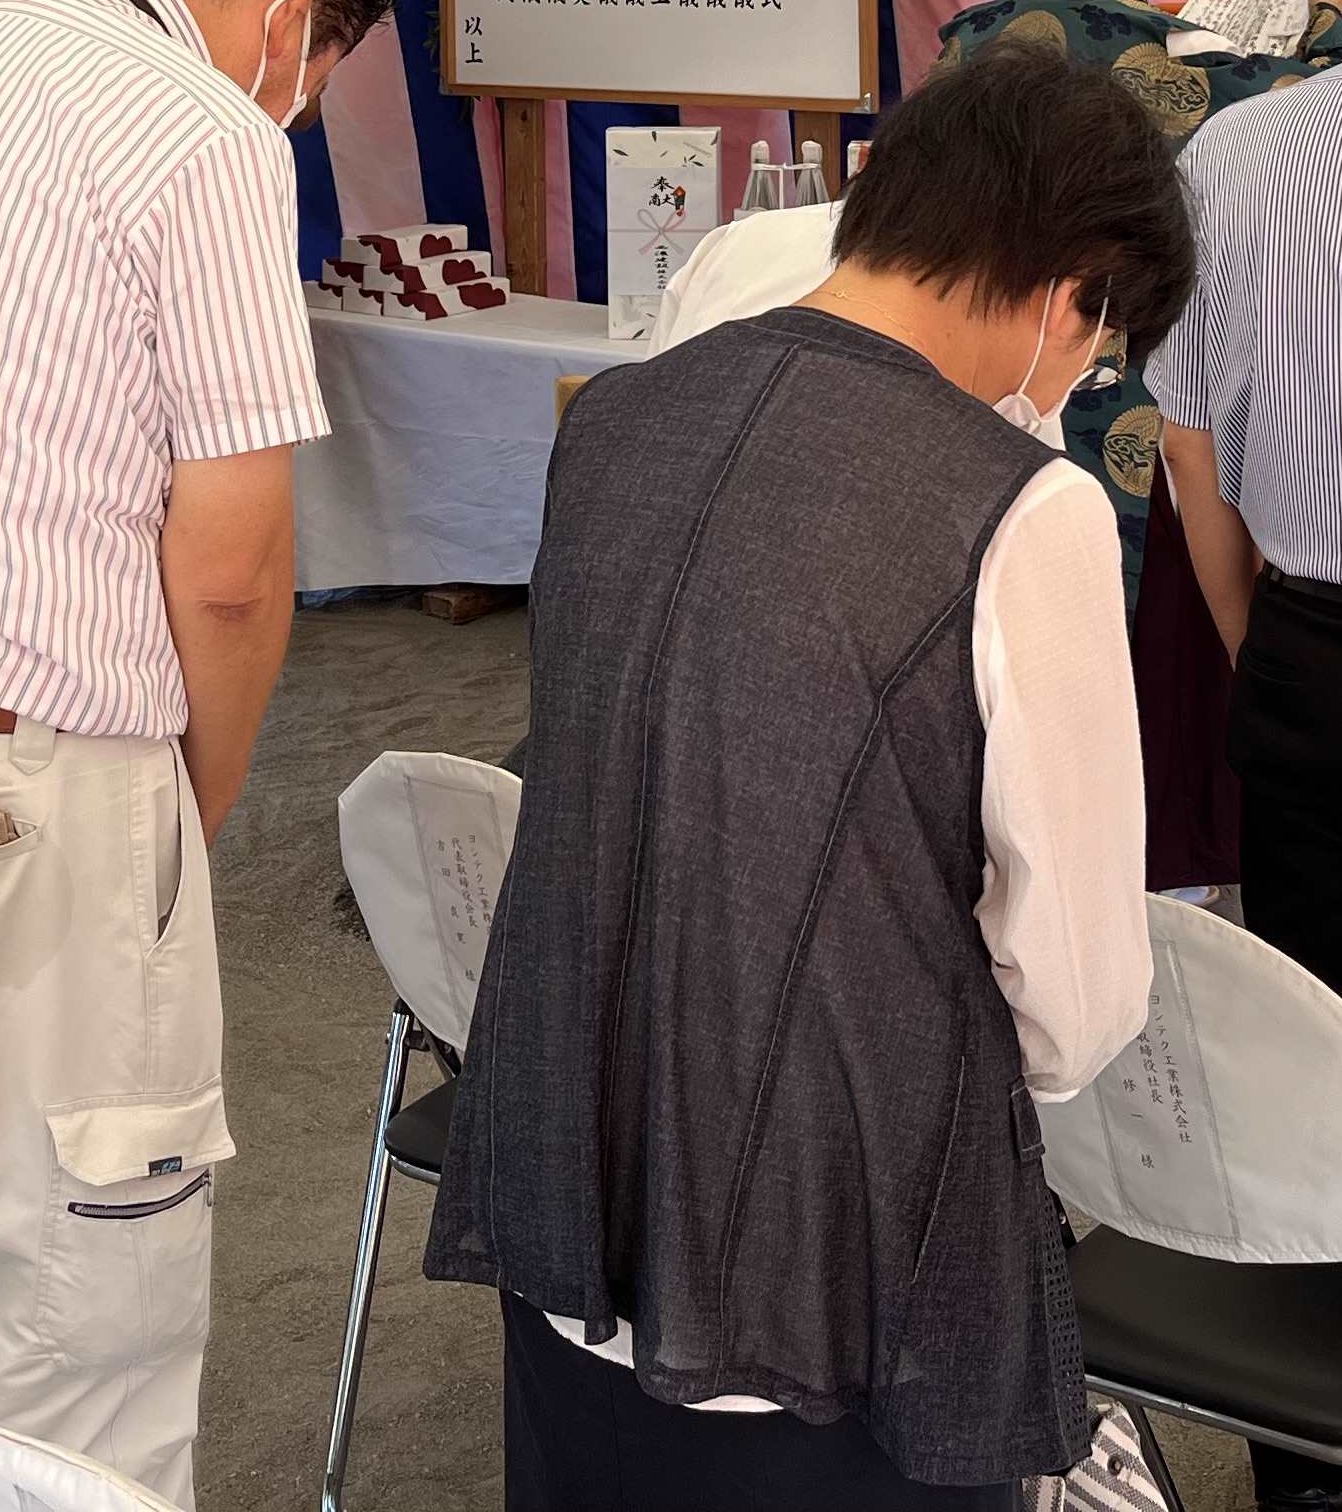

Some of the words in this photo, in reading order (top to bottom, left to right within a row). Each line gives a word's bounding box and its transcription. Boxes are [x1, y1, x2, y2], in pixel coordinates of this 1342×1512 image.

[464, 16, 484, 64] 以上
[1150, 994, 1193, 1144] ヨンテク工業株式会社
